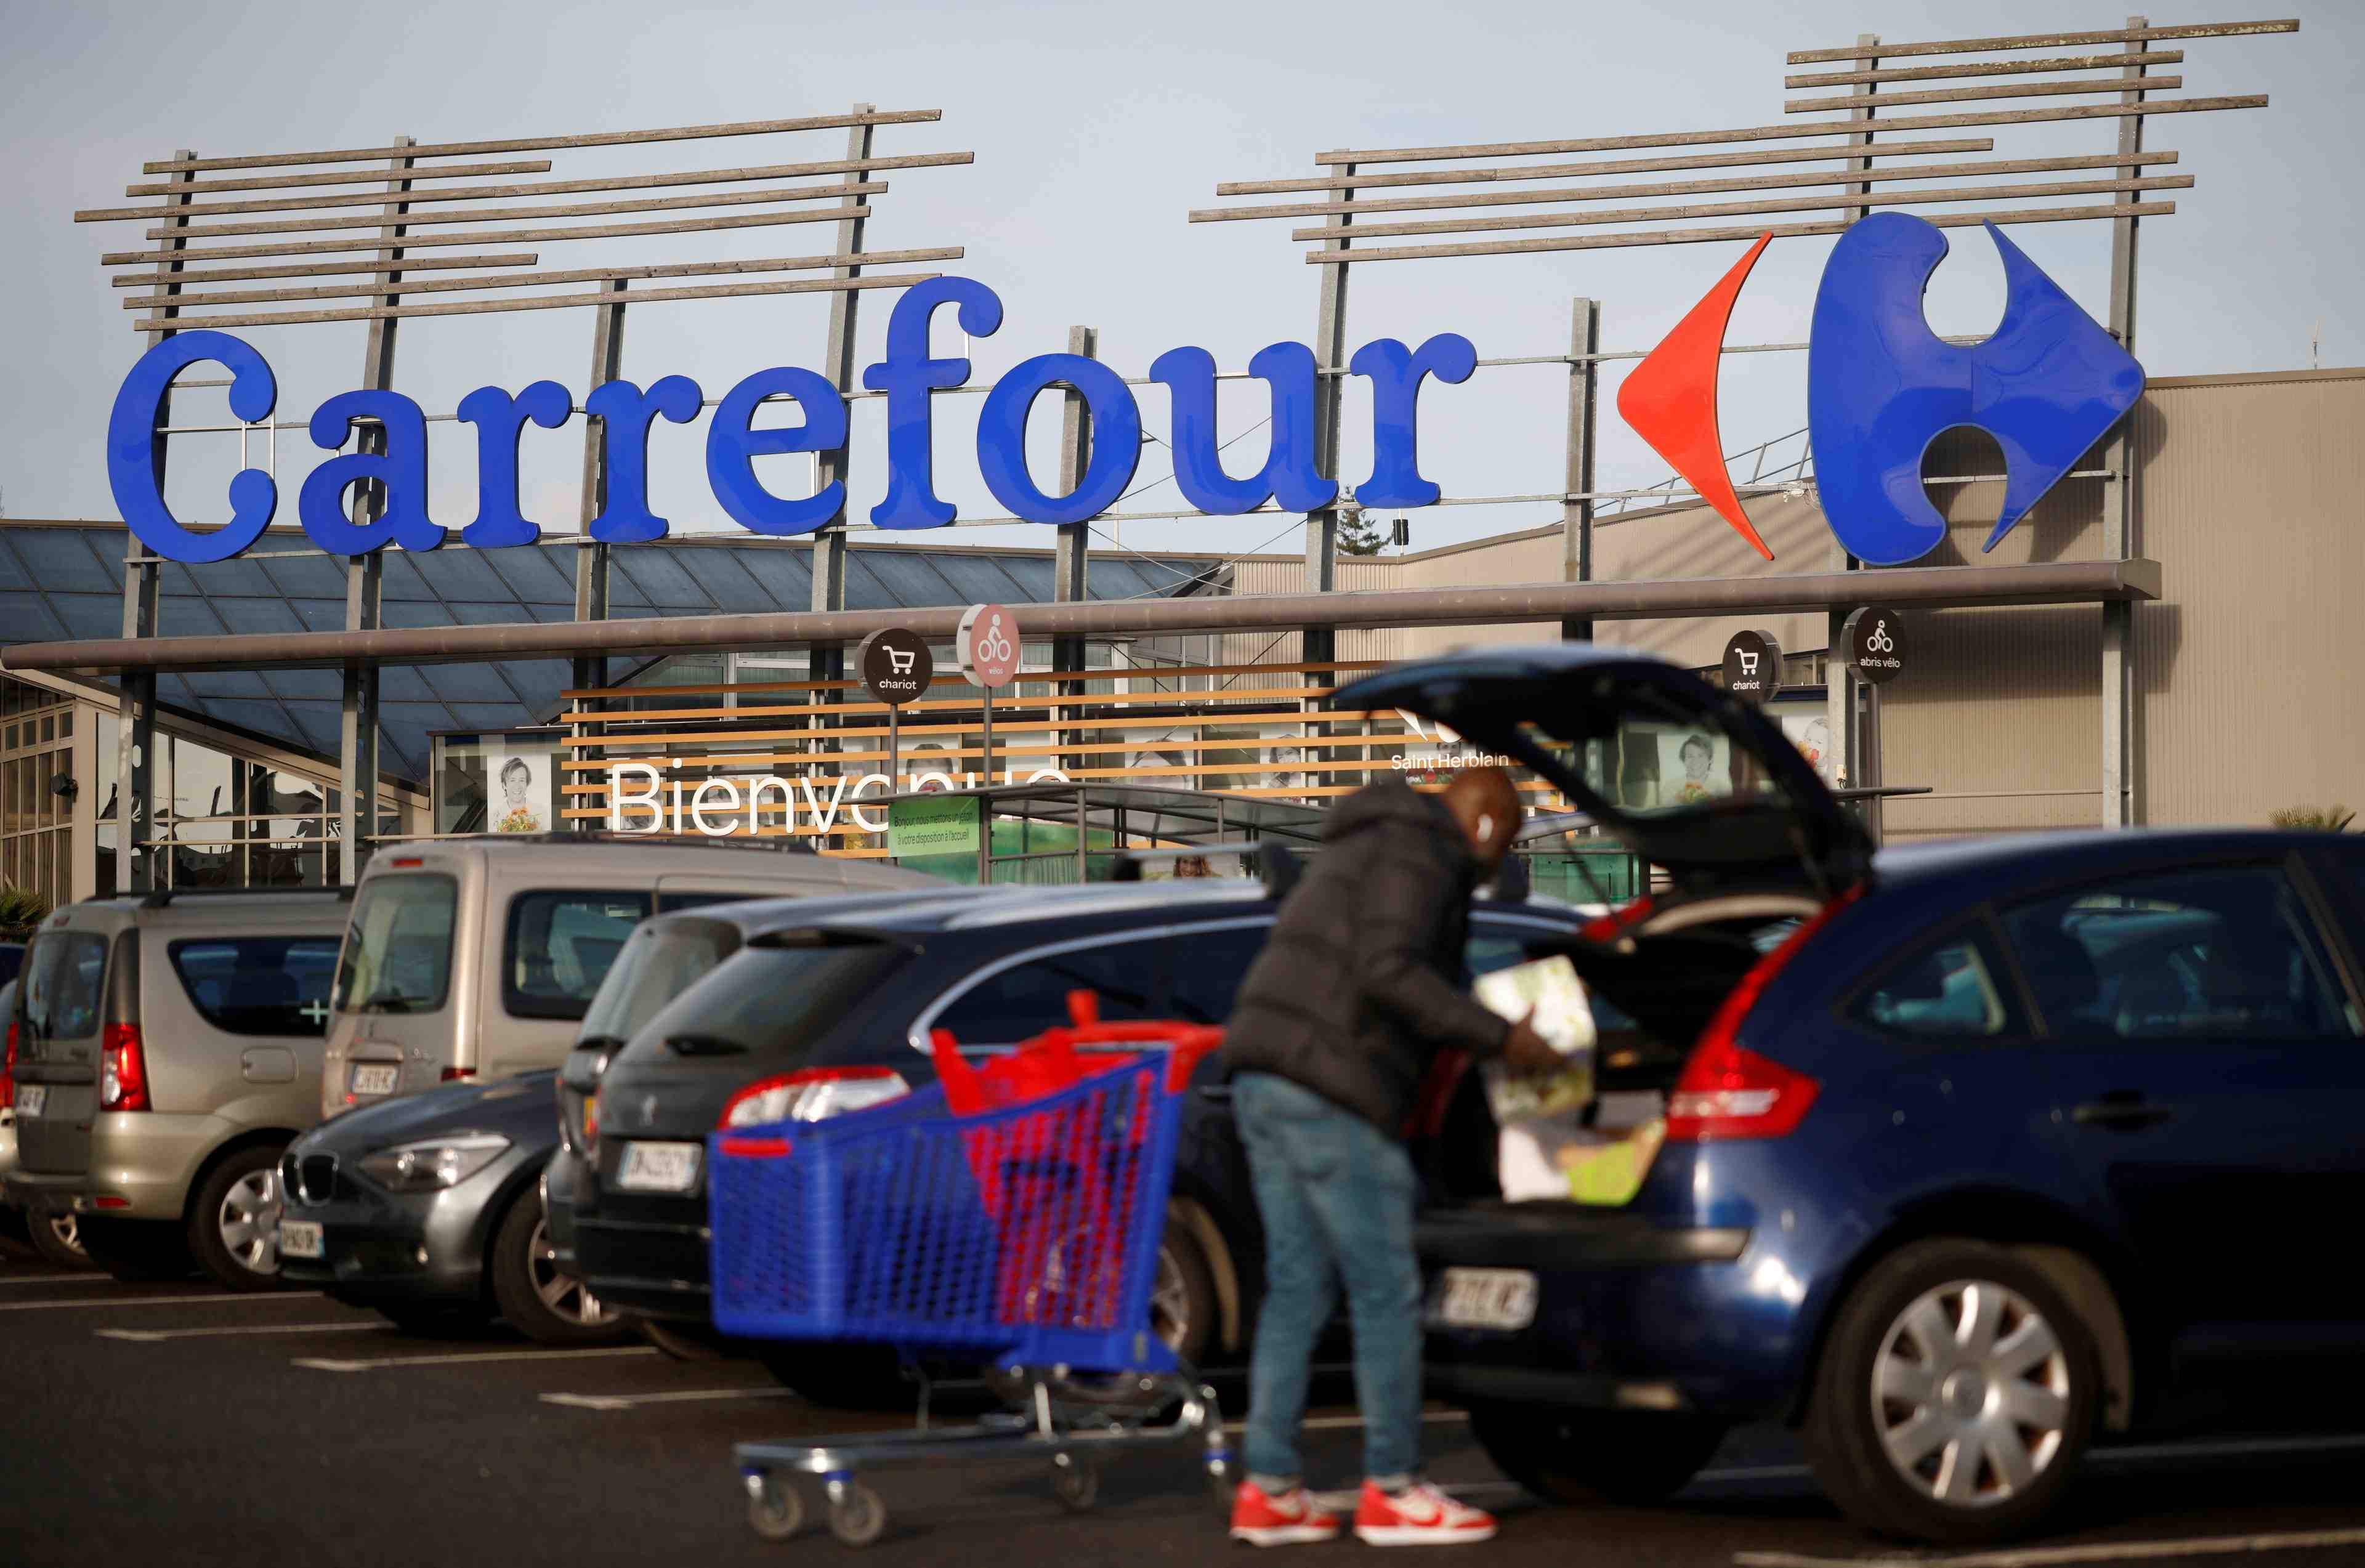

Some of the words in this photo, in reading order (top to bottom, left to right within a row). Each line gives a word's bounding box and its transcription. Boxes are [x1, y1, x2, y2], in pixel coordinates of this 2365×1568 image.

[107, 275, 1477, 565] Carrefour
[1860, 657, 1881, 668] abris
[1883, 657, 1901, 668] vélo
[879, 678, 917, 690] chariot
[1732, 680, 1760, 690] chariot
[1391, 754, 1434, 770] Saint
[1438, 751, 1509, 769] Herblain
[607, 758, 1072, 836] Bienve
[916, 815, 929, 825] nous
[929, 812, 951, 824] mettons
[902, 835, 916, 845] votre
[916, 831, 945, 847] disposition
